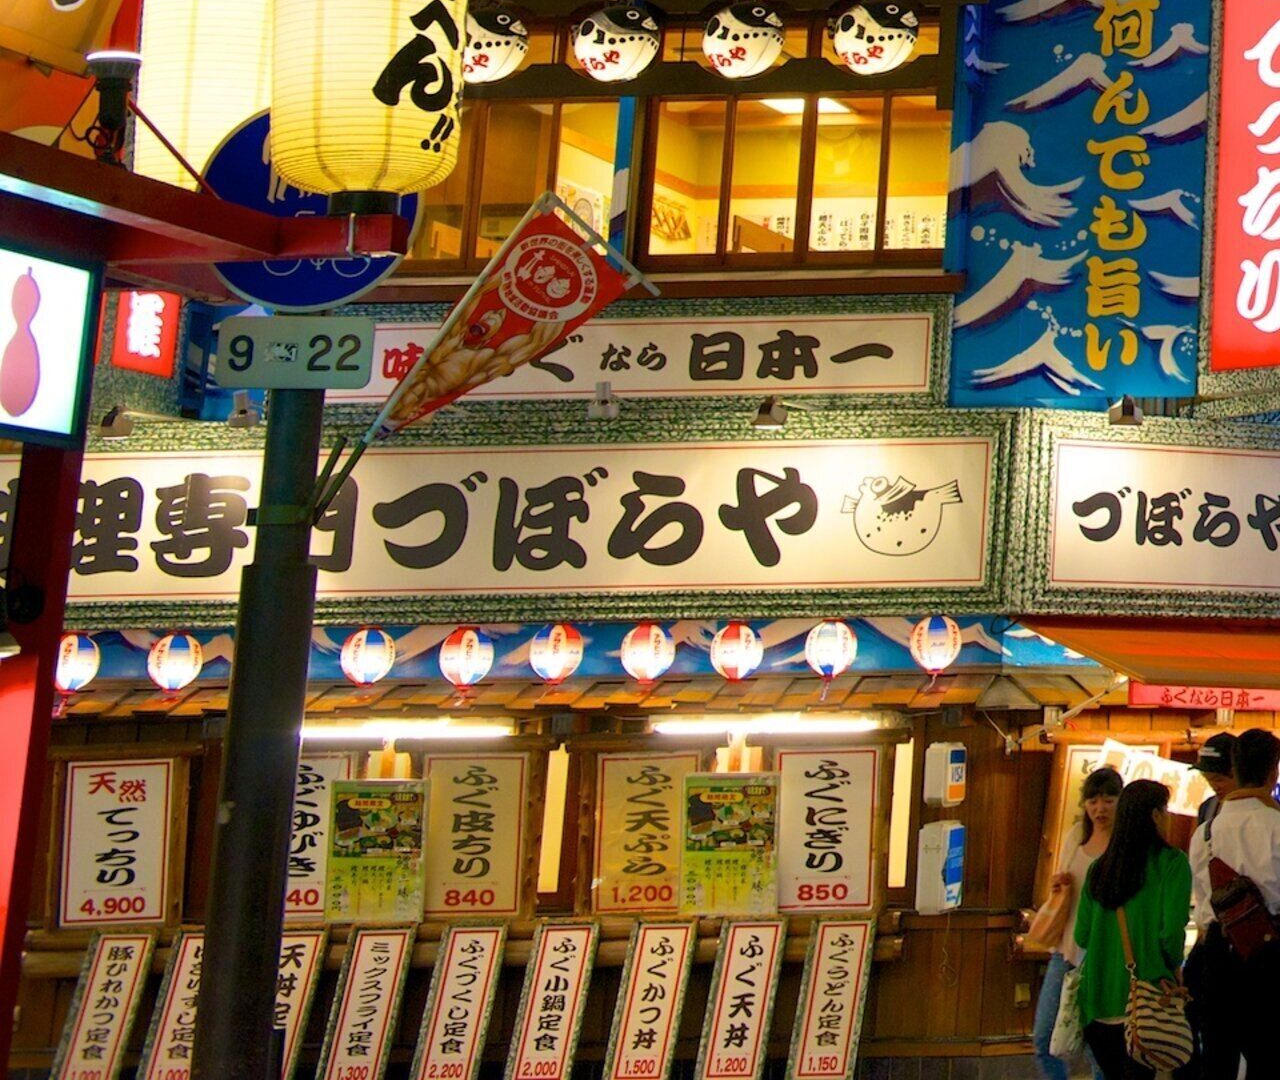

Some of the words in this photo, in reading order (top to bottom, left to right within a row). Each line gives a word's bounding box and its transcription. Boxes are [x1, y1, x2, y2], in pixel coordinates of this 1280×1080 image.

[229, 336, 253, 371] 9
[307, 334, 362, 371] 22
[502, 330, 893, 381] ぐなら日本一
[373, 467, 818, 572] づぼらや
[88, 771, 147, 803] 天然
[451, 766, 498, 878] ふぐ皮ちり
[622, 765, 674, 877] ふぐ天ぷら
[804, 760, 850, 874] ふぐにぎり
[951, 766, 964, 783] VISA
[95, 806, 140, 887] てっちり
[286, 888, 319, 907] 40
[443, 888, 495, 906] 840
[798, 884, 848, 901] 850
[81, 944, 135, 1060] 豚ひれかつ定食
[345, 941, 391, 1058] ミックスフライ定食
[438, 939, 485, 1054] ふぐづくし定食
[533, 937, 578, 1052] ふぐ小鍋定食
[632, 935, 675, 1050] ふぐかつ丼
[723, 935, 764, 1049] ふぐ天丼
[814, 932, 855, 1048] ふぐうどん定食
